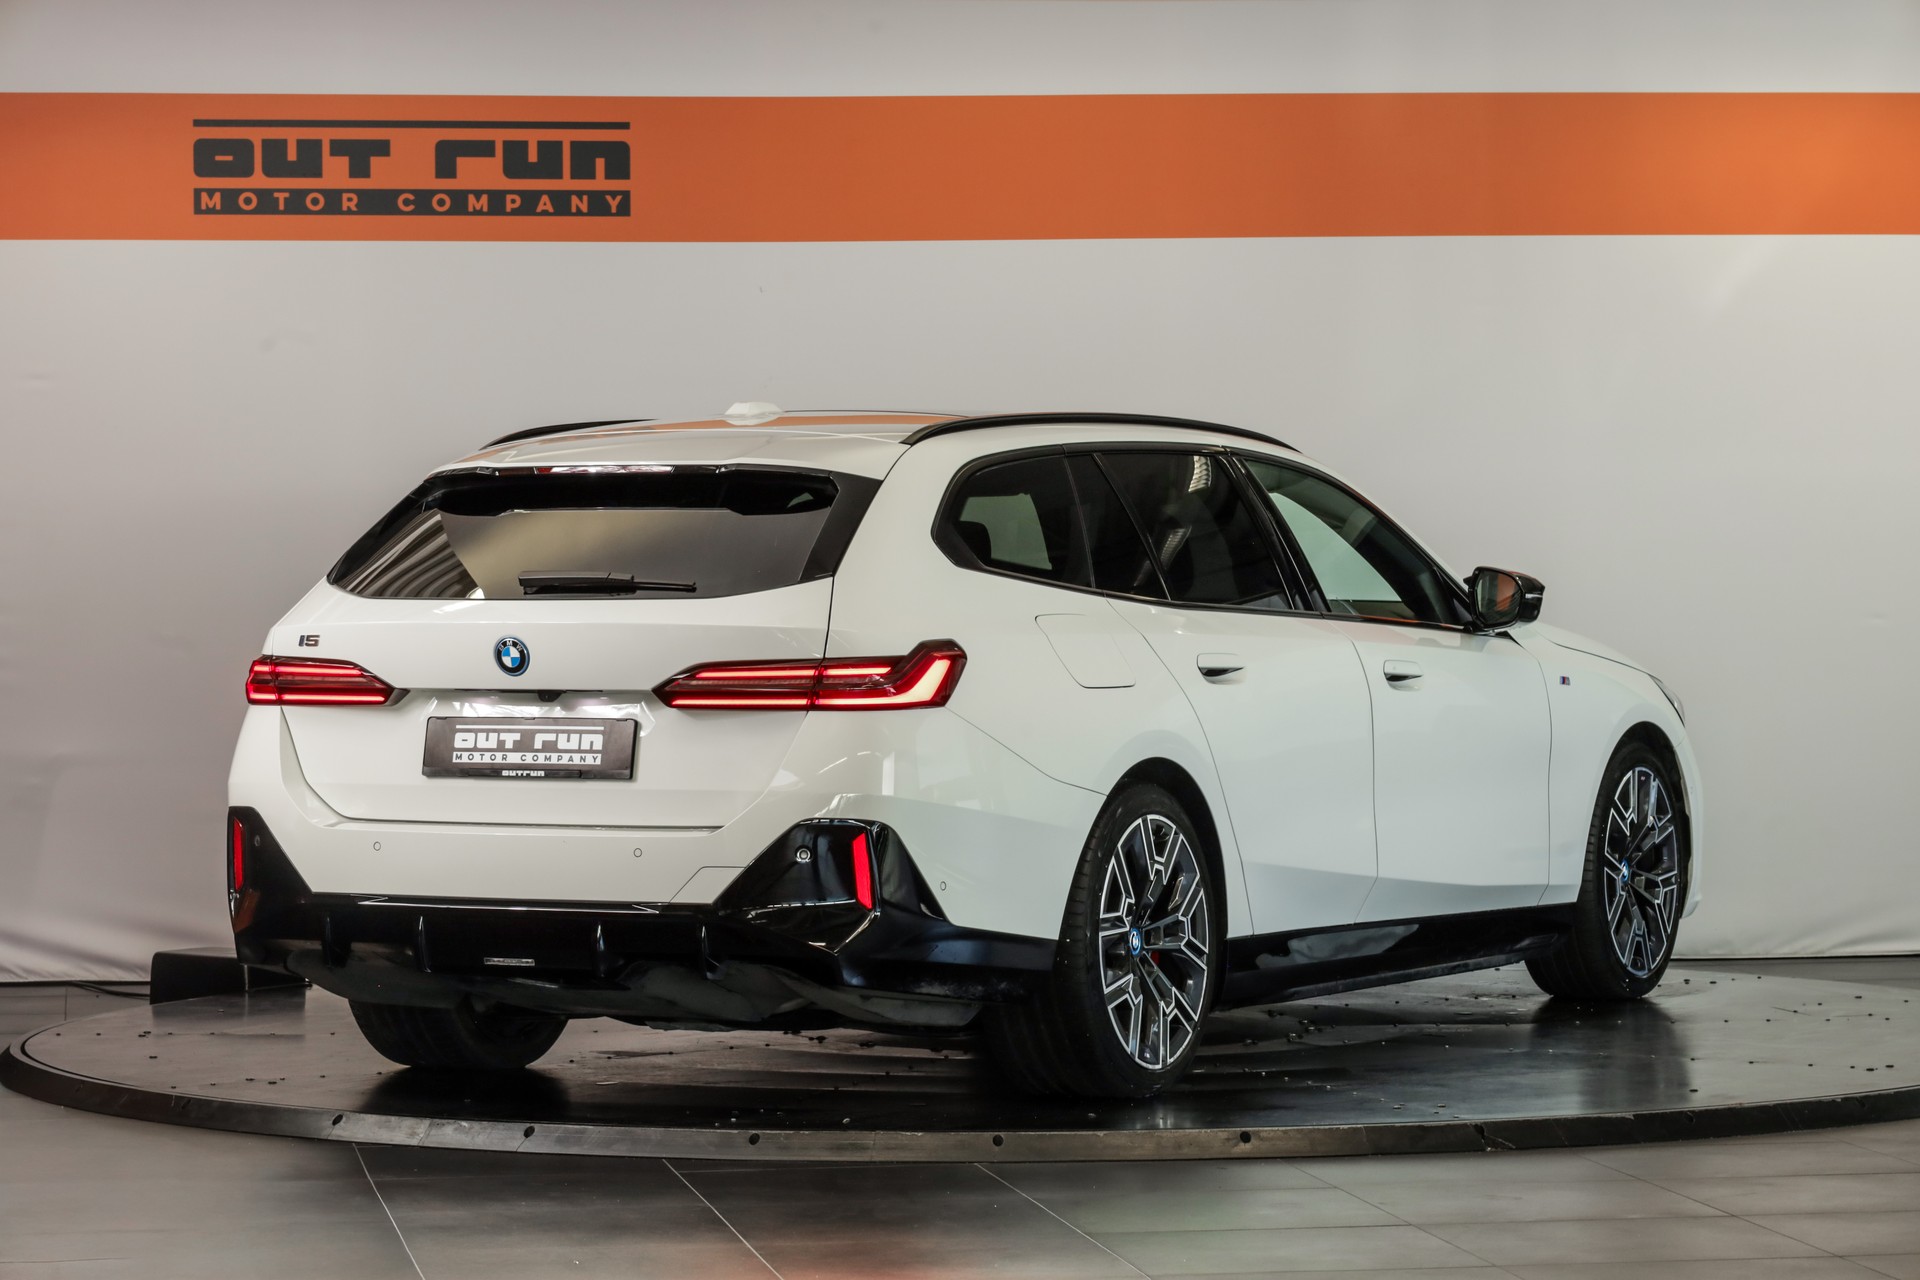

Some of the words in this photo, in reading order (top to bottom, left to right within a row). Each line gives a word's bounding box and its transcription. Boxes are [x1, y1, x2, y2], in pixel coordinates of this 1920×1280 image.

[200, 191, 359, 212] MOTOR
[397, 193, 624, 214] COMPANY
[455, 753, 508, 762] MOTOR
[520, 754, 599, 763] COMPANY
